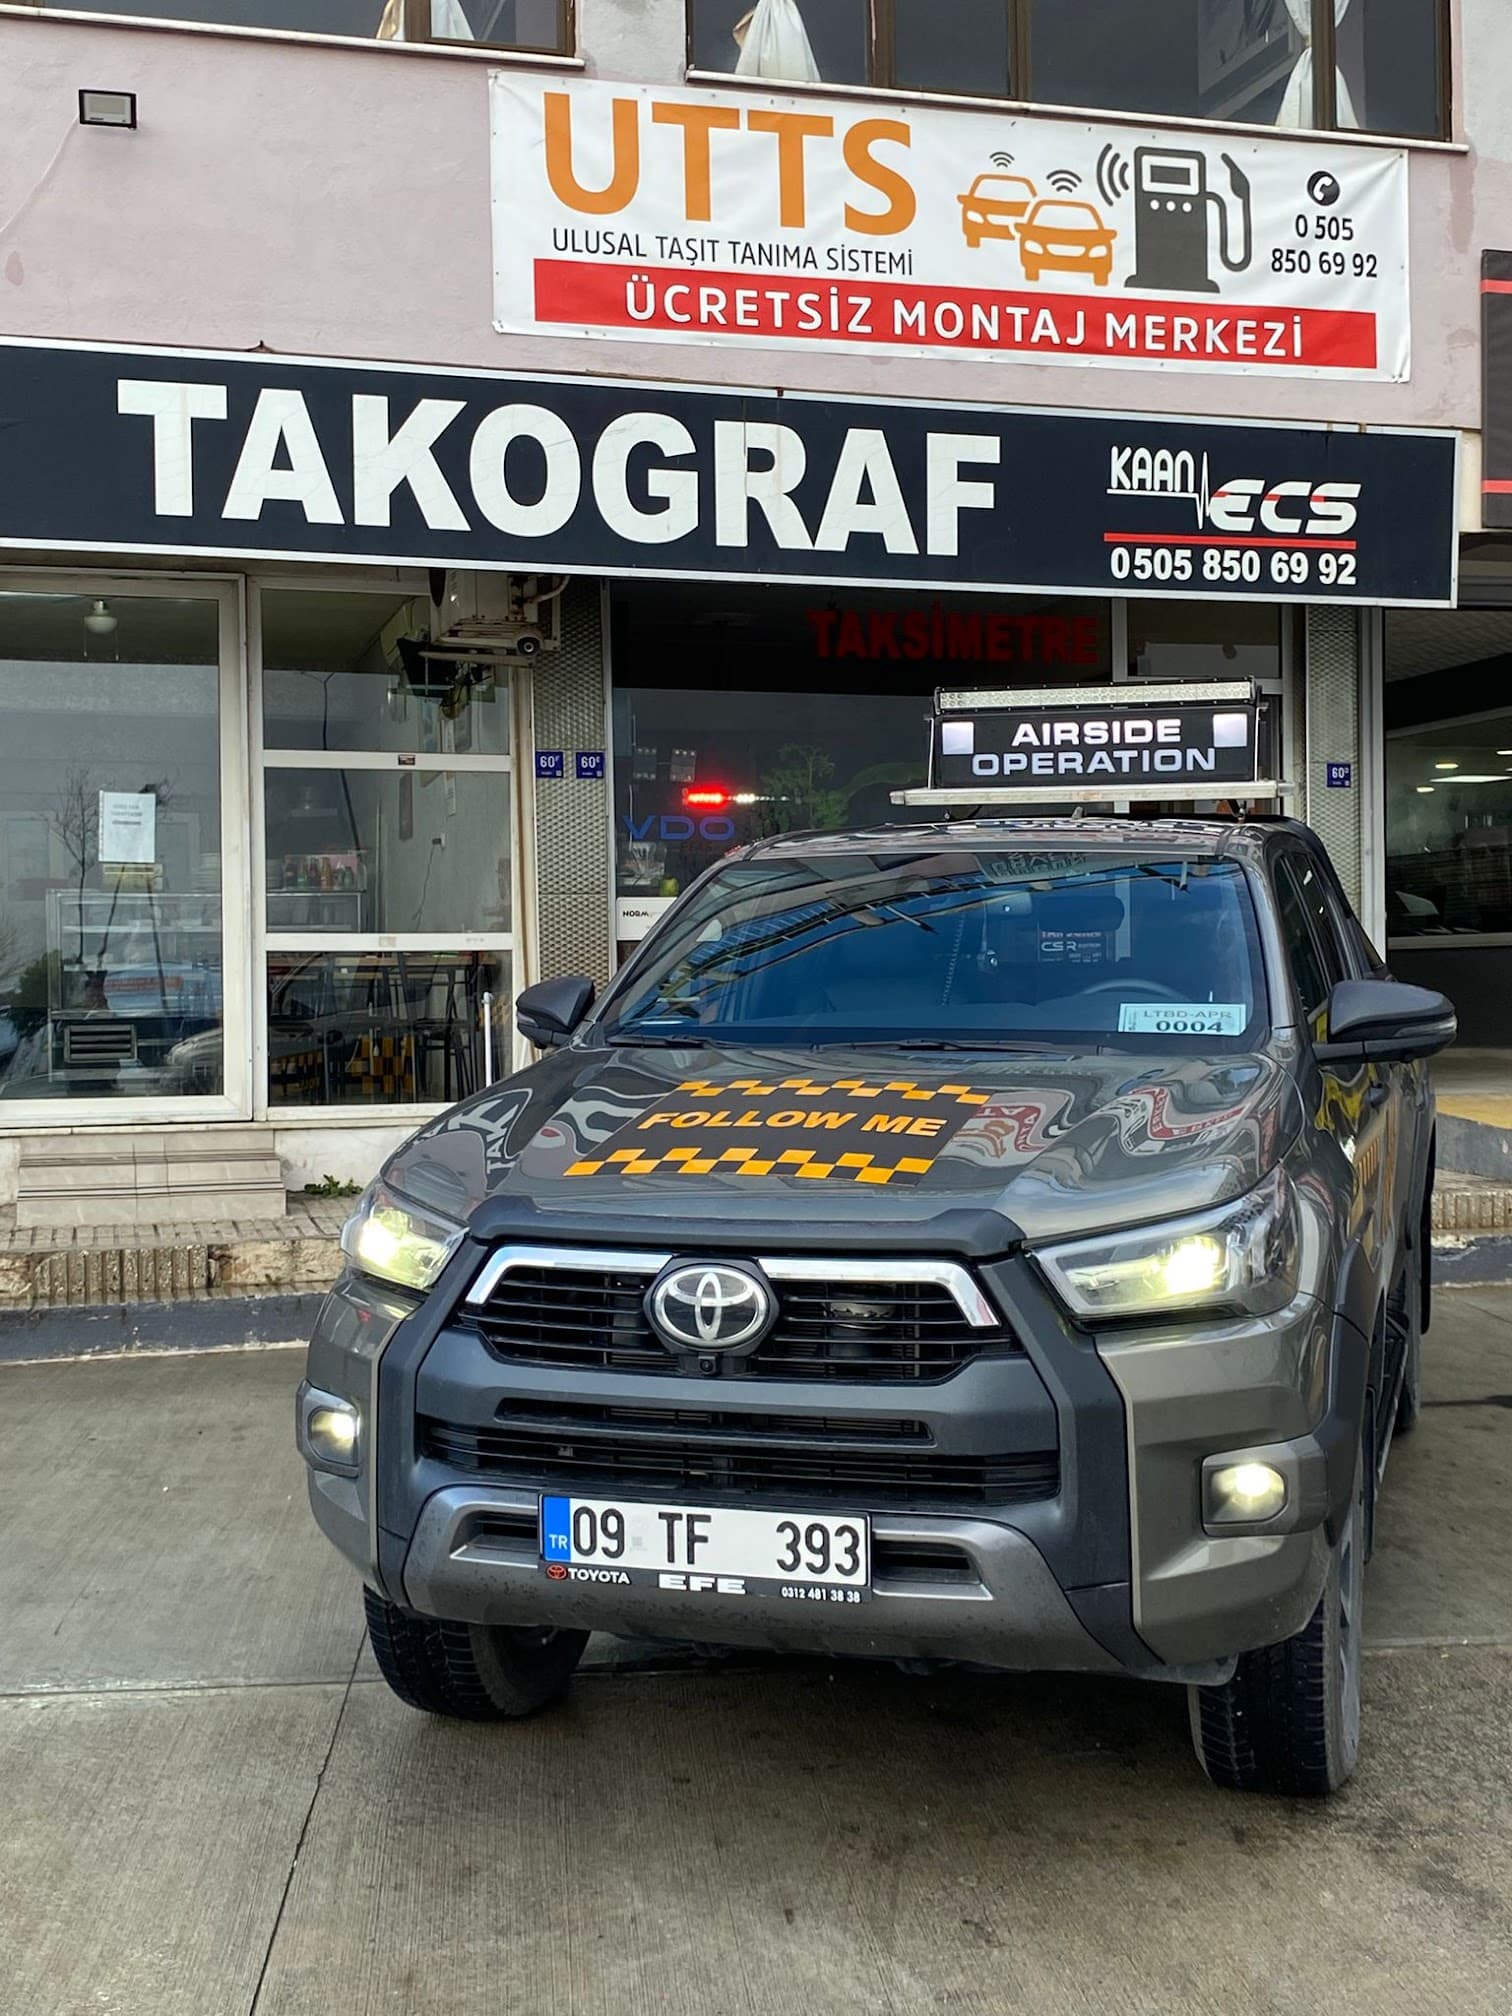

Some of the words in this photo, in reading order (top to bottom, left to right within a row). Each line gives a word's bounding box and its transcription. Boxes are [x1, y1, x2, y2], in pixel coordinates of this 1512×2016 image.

[543, 91, 917, 236] UTTS
[1295, 214, 1308, 238] 0
[1314, 215, 1354, 241] 505
[552, 227, 648, 258] ULUSAL
[655, 235, 720, 266] TAŞIT
[728, 241, 818, 270] TANIMA
[827, 244, 914, 276] SİSTEMİ
[1271, 248, 1311, 274] 850
[1318, 251, 1345, 276] 69
[1352, 253, 1378, 278] 92
[625, 274, 873, 334] ÜCRETSİZ
[893, 299, 1085, 346] MONTAJ
[1105, 312, 1303, 357] MERKEZİ
[117, 378, 1002, 558] TAKOGRAF
[1110, 446, 1195, 493] KAAN
[1209, 479, 1362, 534] ECS
[1202, 548, 1261, 582] 850
[1270, 551, 1310, 584] 69
[1318, 552, 1357, 585] 92
[807, 598, 1099, 664] TAKSİMETRE
[1011, 718, 1182, 747] AIRSIDE
[971, 747, 1216, 776] OPERATION
[622, 815, 736, 841] VDO
[1143, 1010, 1232, 1019] LTBD-APR
[1156, 1020, 1224, 1033] 0004
[637, 1110, 858, 1130] FOLLOW
[861, 1114, 948, 1137] ME
[549, 1533, 568, 1549] TR
[573, 1506, 625, 1559] 09
[658, 1511, 712, 1565] TF
[776, 1520, 860, 1577] 393
[567, 1567, 631, 1585] TOYOTA
[659, 1573, 746, 1595] EFE
[781, 1586, 805, 1599] 0312
[807, 1587, 827, 1601] 481
[830, 1589, 844, 1602] 38
[846, 1590, 860, 1603] 38
